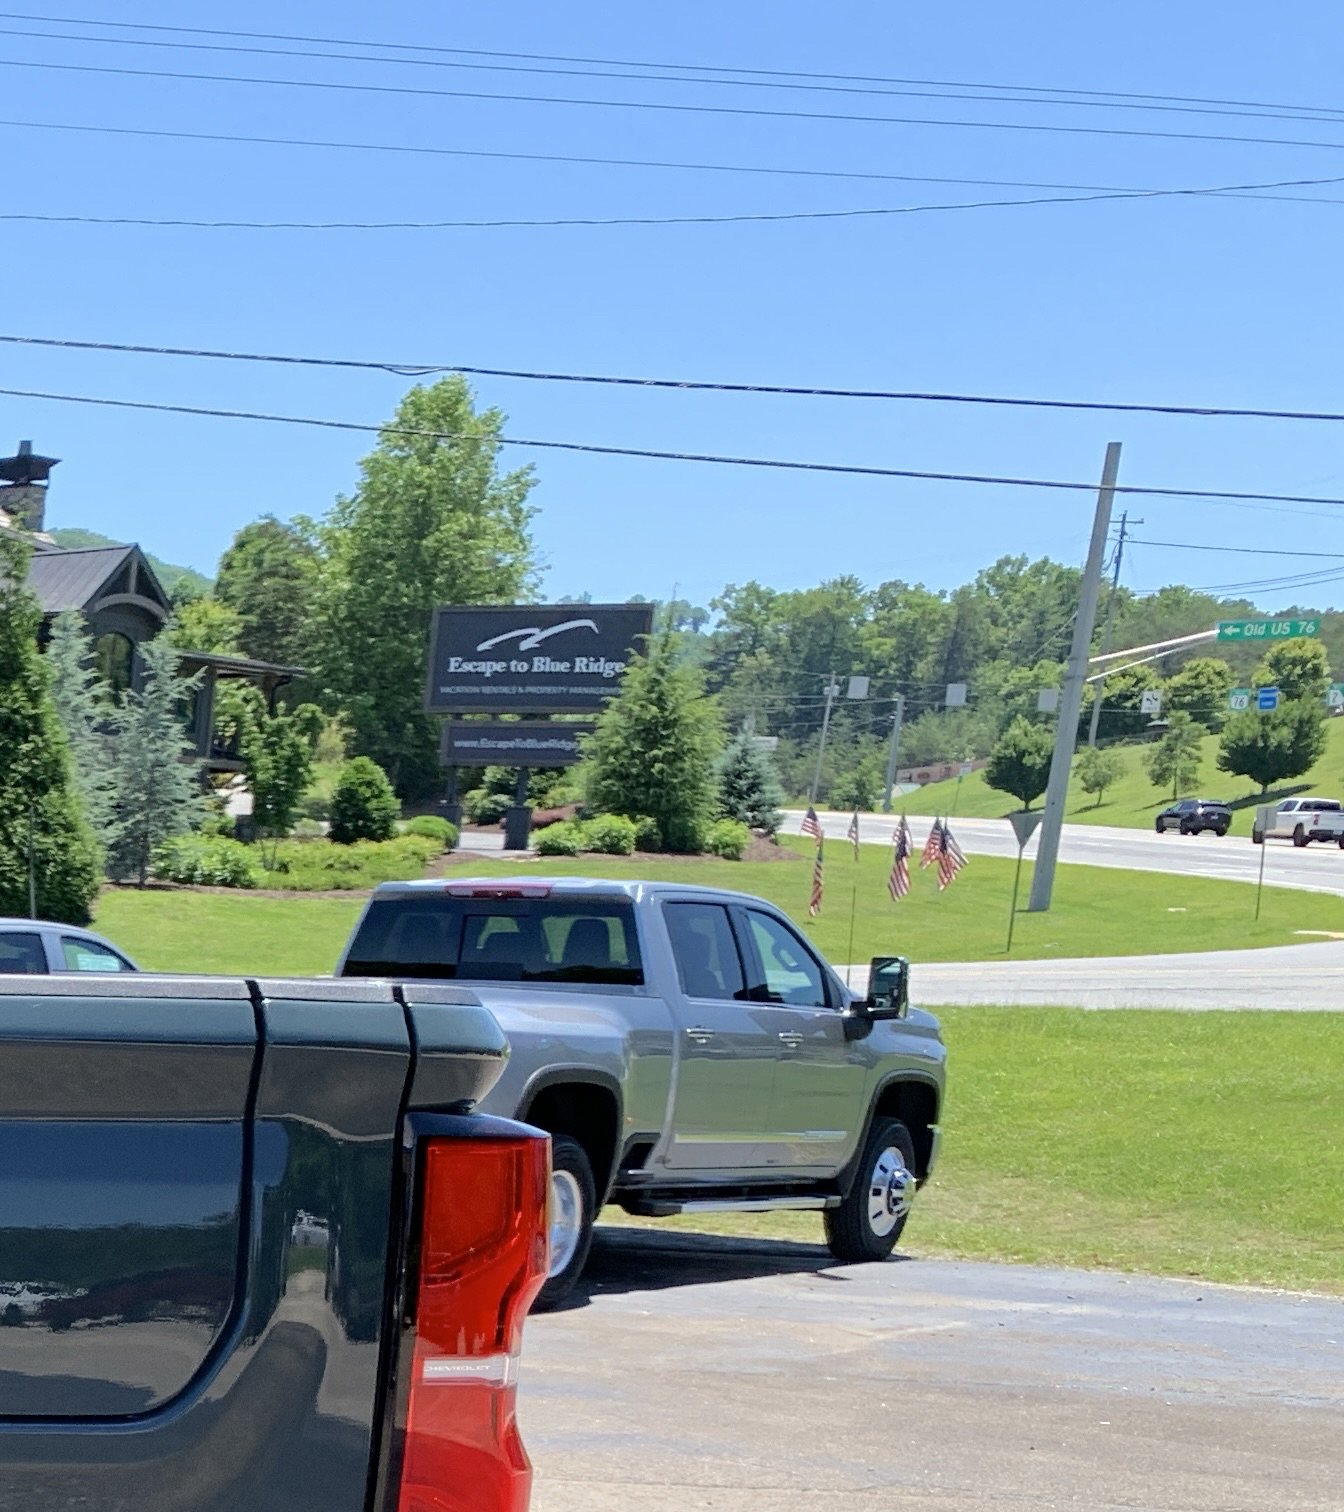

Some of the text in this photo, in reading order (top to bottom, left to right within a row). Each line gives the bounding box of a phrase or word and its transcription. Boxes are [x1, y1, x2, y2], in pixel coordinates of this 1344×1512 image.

[1244, 621, 1315, 636] Old US 76
[447, 656, 625, 678] Escape to Blue Ridge
